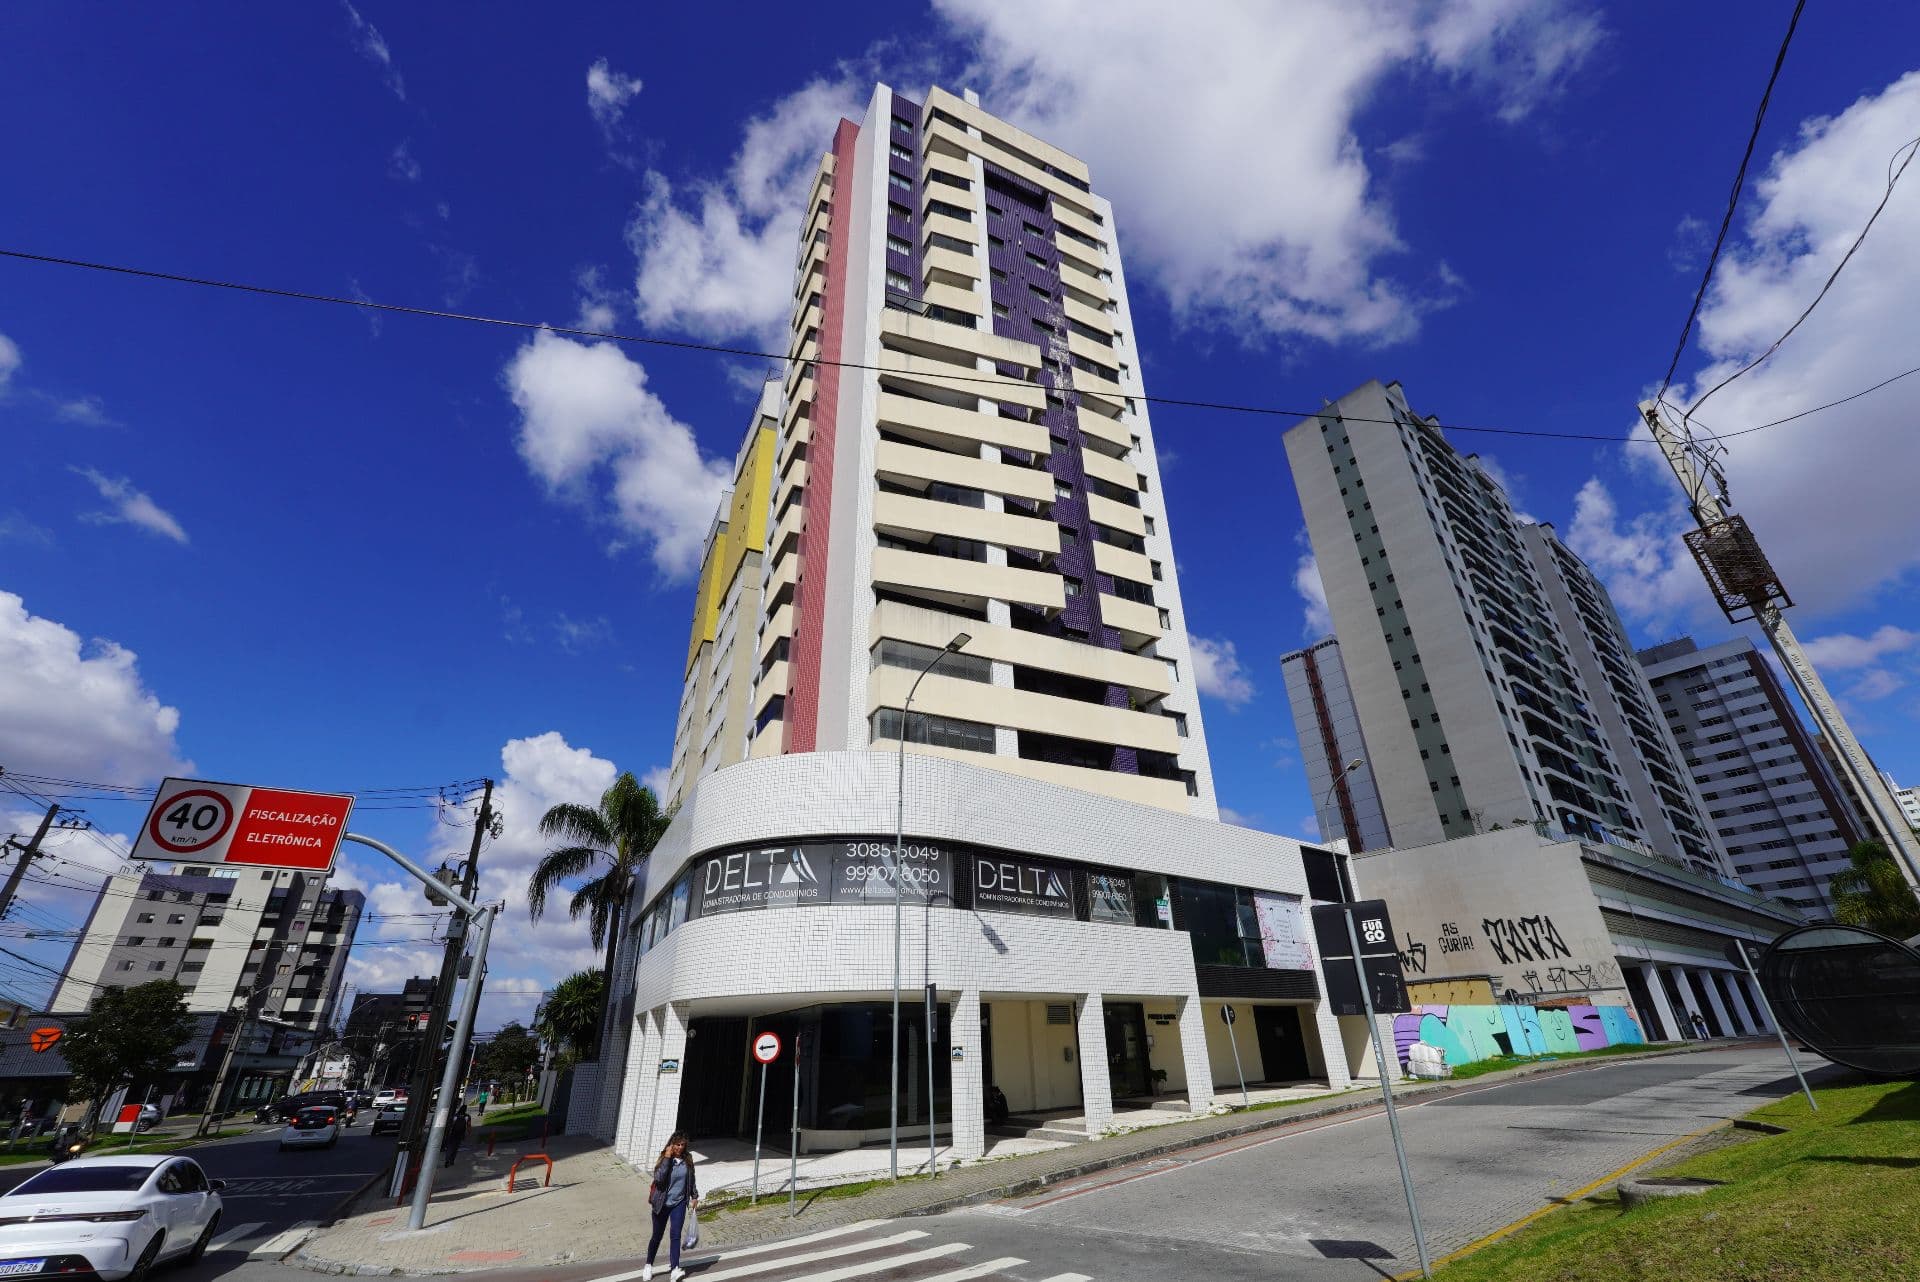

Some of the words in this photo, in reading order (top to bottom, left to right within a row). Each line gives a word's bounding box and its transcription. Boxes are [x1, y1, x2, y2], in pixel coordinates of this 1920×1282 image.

[166, 802, 219, 832] 40
[248, 809, 337, 828] FISCALIZAÇÃO
[170, 834, 198, 845] km/h
[246, 831, 322, 848] ELETRÔNICA
[752, 892, 763, 901] DE
[1362, 920, 1384, 932] FUN
[1441, 922, 1459, 937] AS
[1364, 929, 1386, 942] GO
